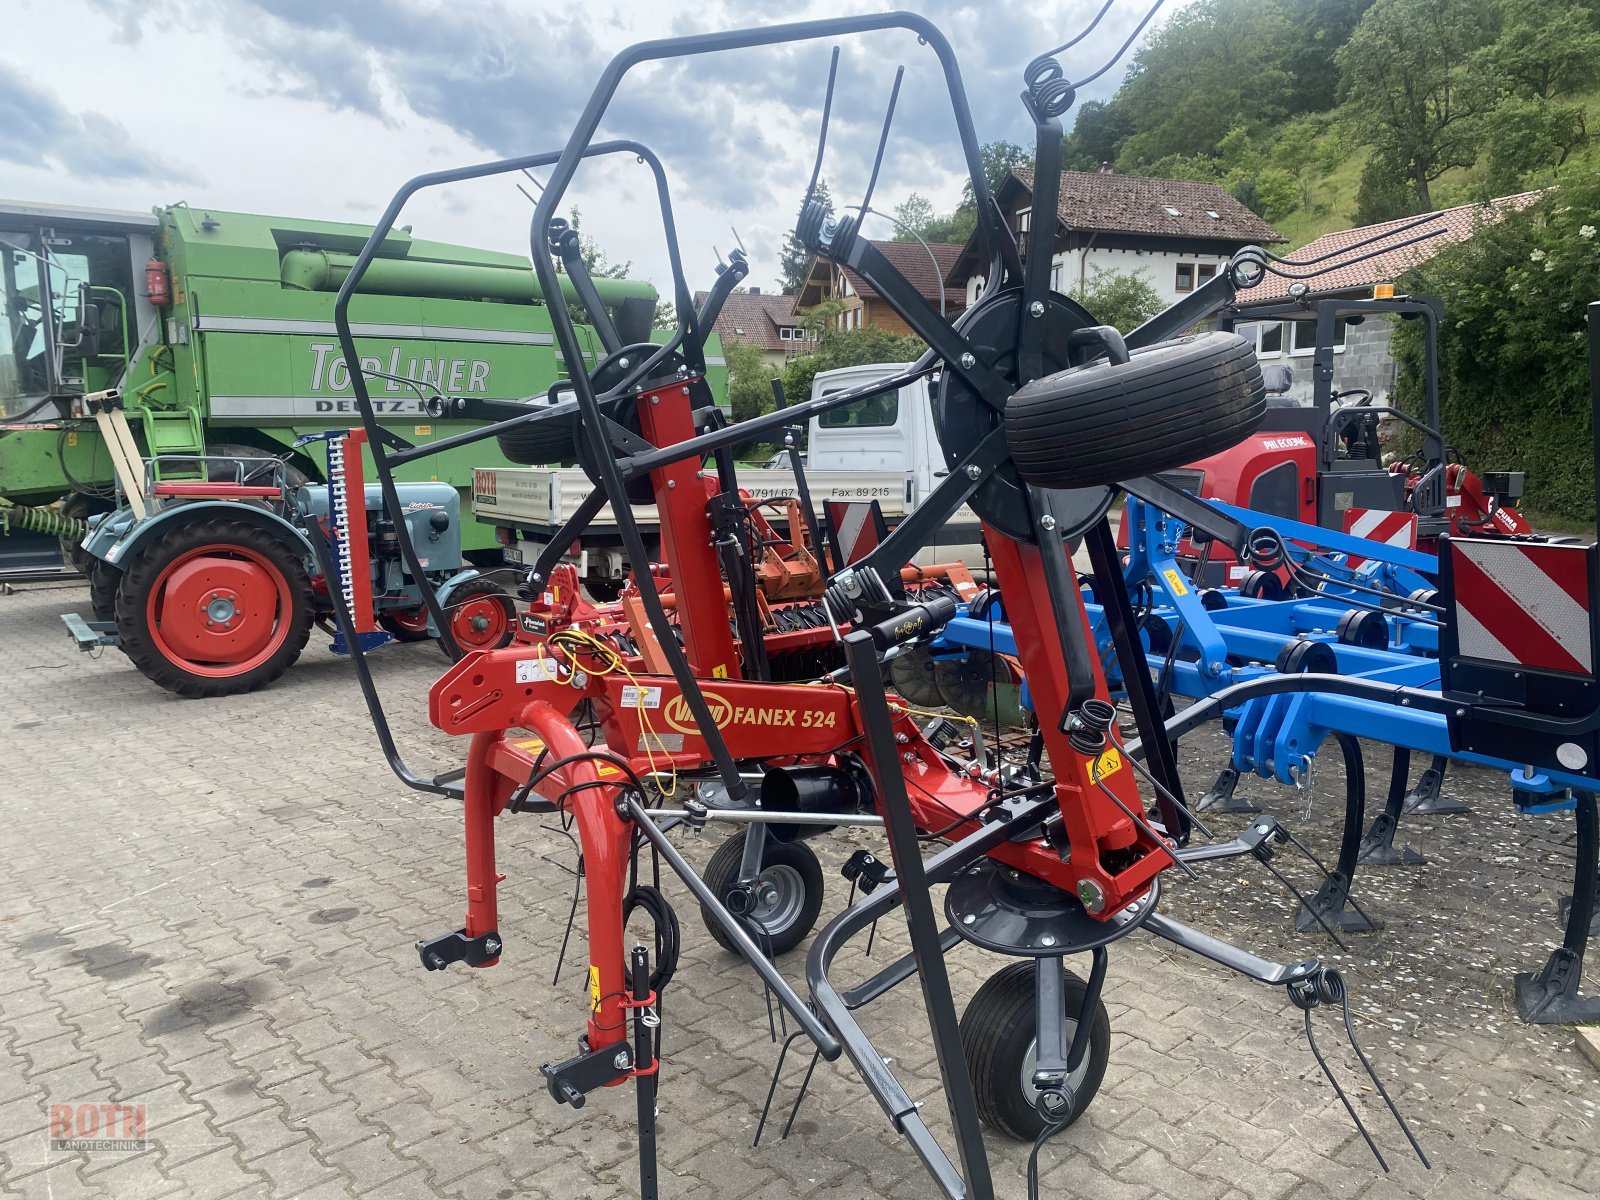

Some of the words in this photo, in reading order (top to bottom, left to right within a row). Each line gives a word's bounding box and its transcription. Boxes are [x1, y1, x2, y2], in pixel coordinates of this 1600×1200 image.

[475, 470, 497, 496] ROTH
[831, 487, 853, 497] Fax:
[856, 487, 869, 497] 89
[871, 487, 890, 497] 215
[1497, 507, 1518, 529] PUMA
[733, 706, 797, 727] FANEX
[801, 710, 836, 728] 524
